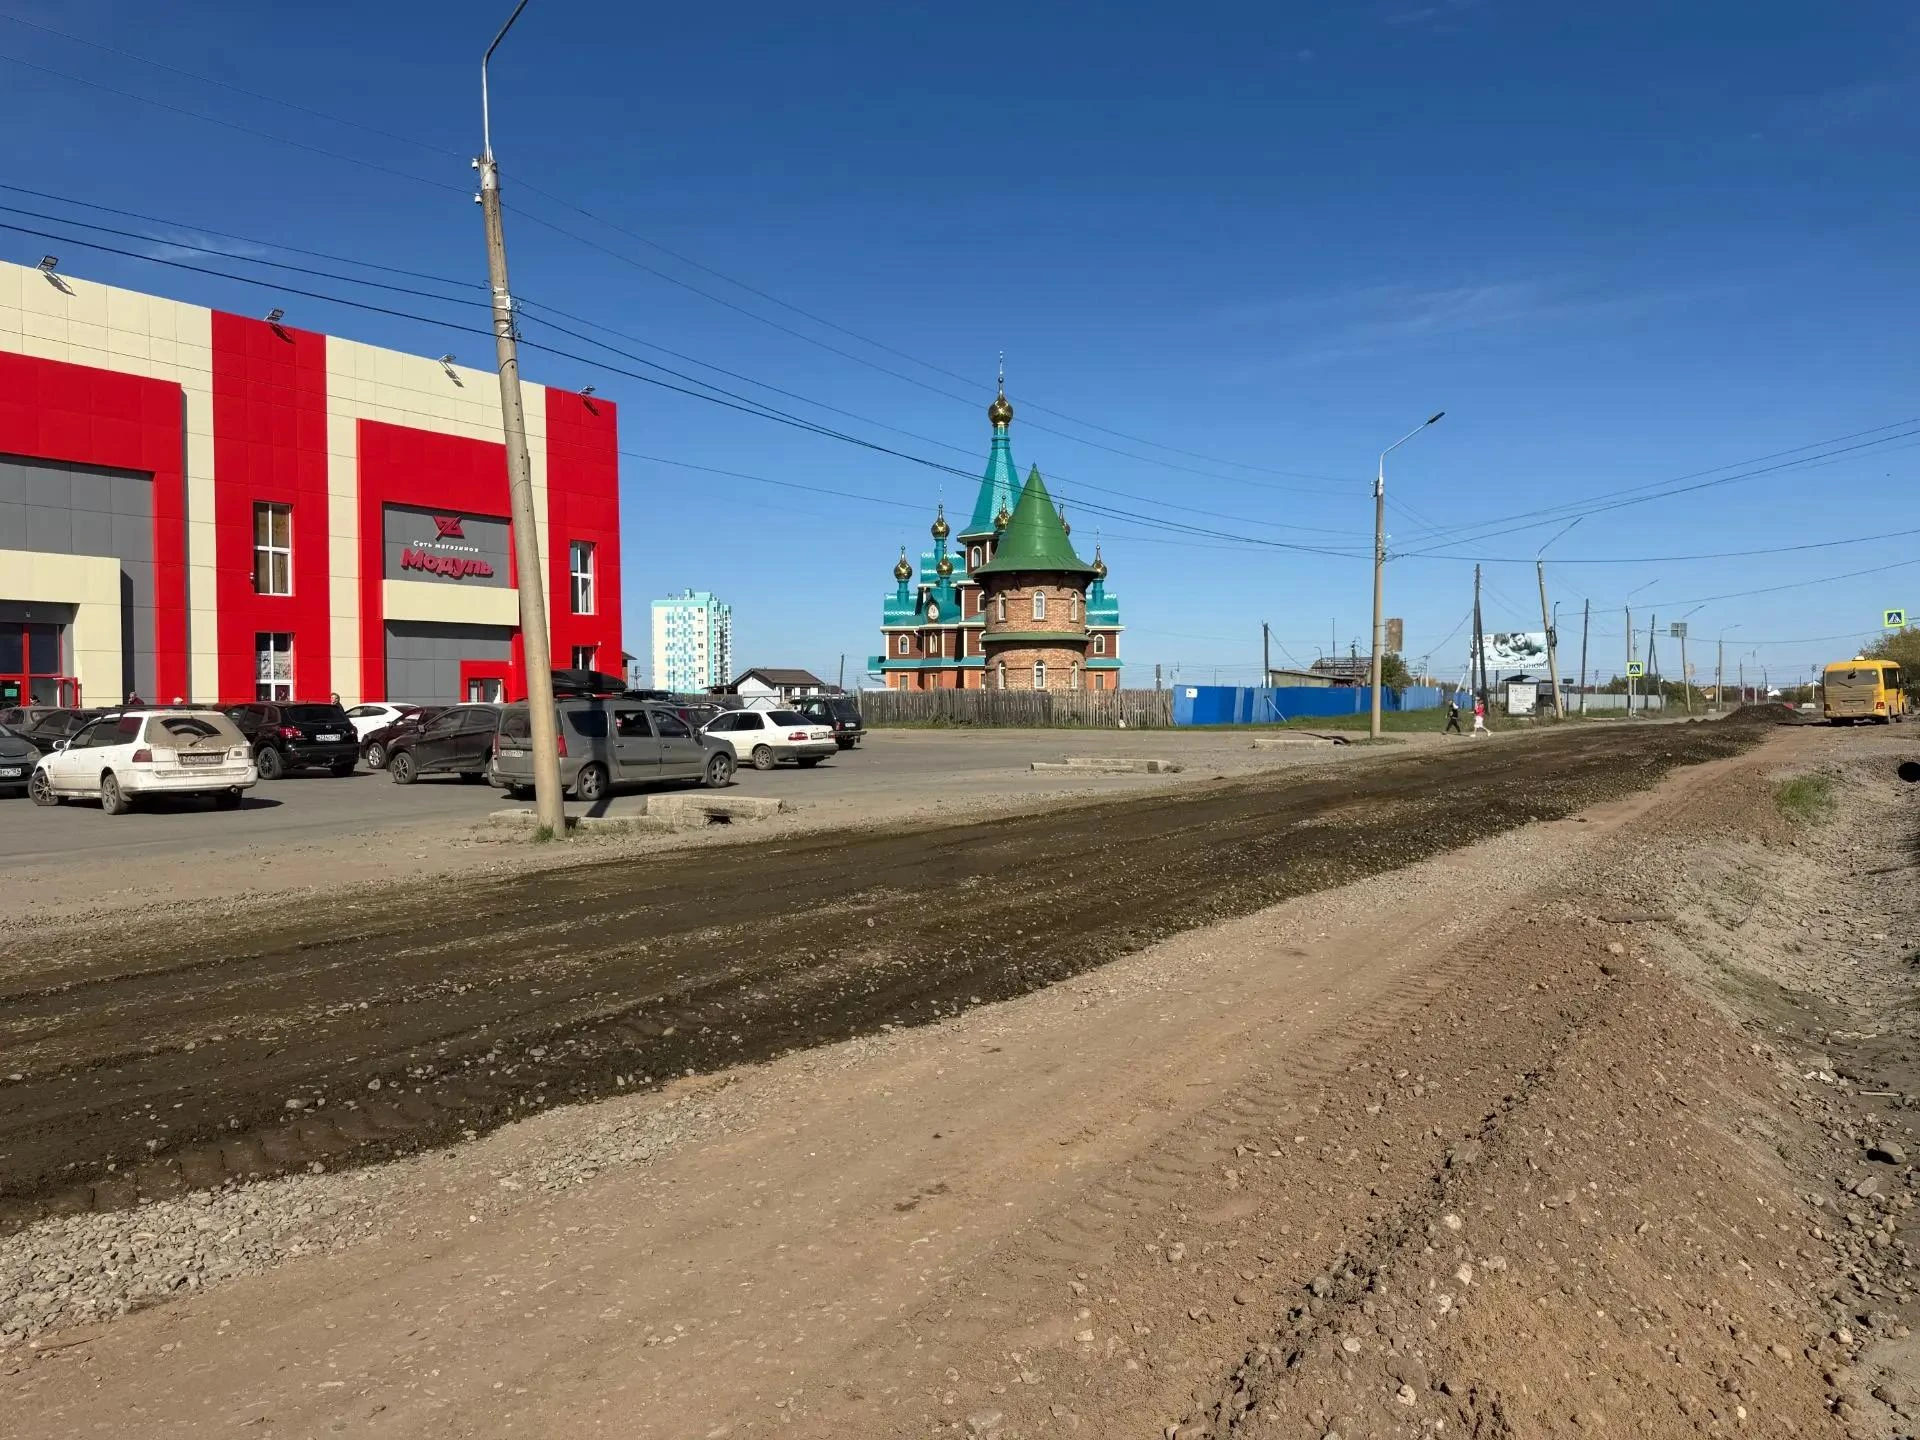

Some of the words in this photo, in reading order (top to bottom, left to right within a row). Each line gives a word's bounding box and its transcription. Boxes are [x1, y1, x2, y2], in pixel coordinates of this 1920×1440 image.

[413, 540, 432, 548] Сеть
[434, 543, 479, 552] магазинов
[401, 548, 494, 578] Модуль
